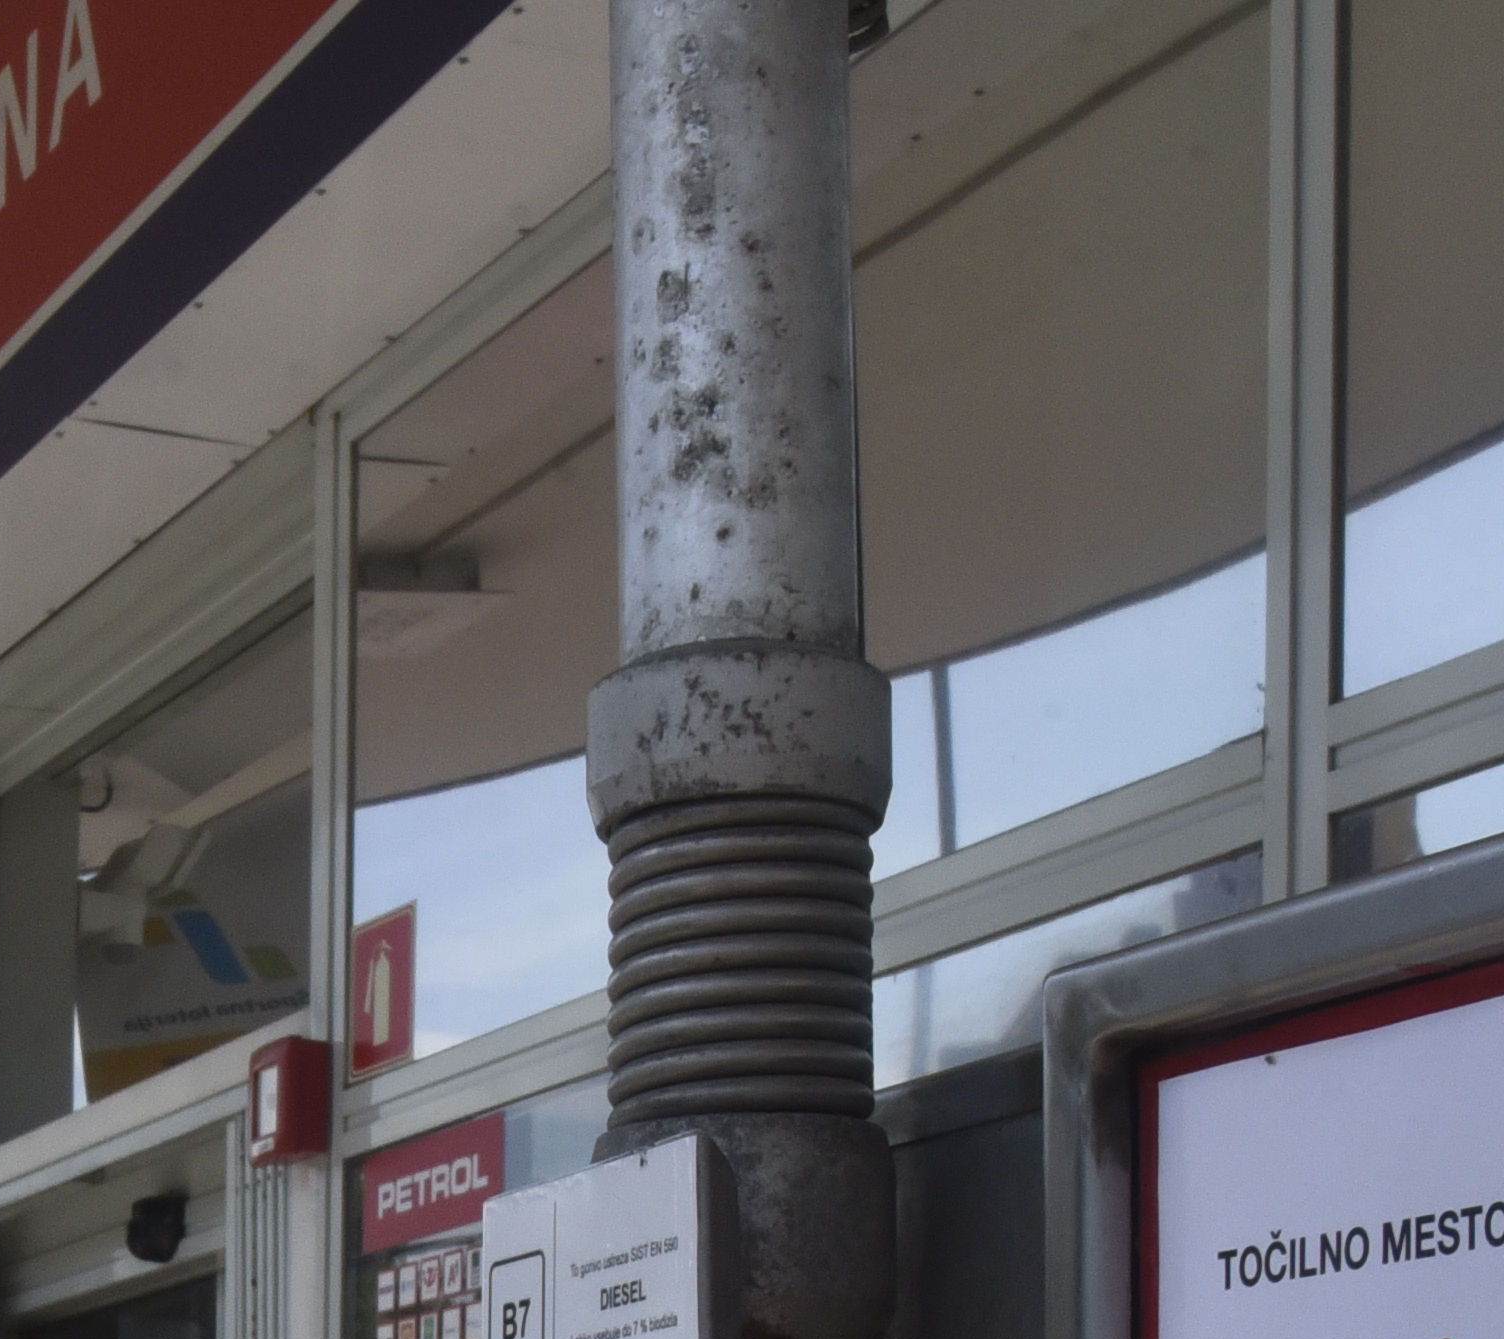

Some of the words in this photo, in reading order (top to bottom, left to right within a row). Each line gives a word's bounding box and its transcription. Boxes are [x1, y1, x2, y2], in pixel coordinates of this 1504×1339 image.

[376, 1153, 490, 1221] PETROL
[630, 1244, 649, 1263] SIST
[650, 1239, 663, 1258] EN
[1217, 1227, 1370, 1291] TOČILNO
[599, 1279, 647, 1312] DIESEL
[622, 1322, 633, 1338] do
